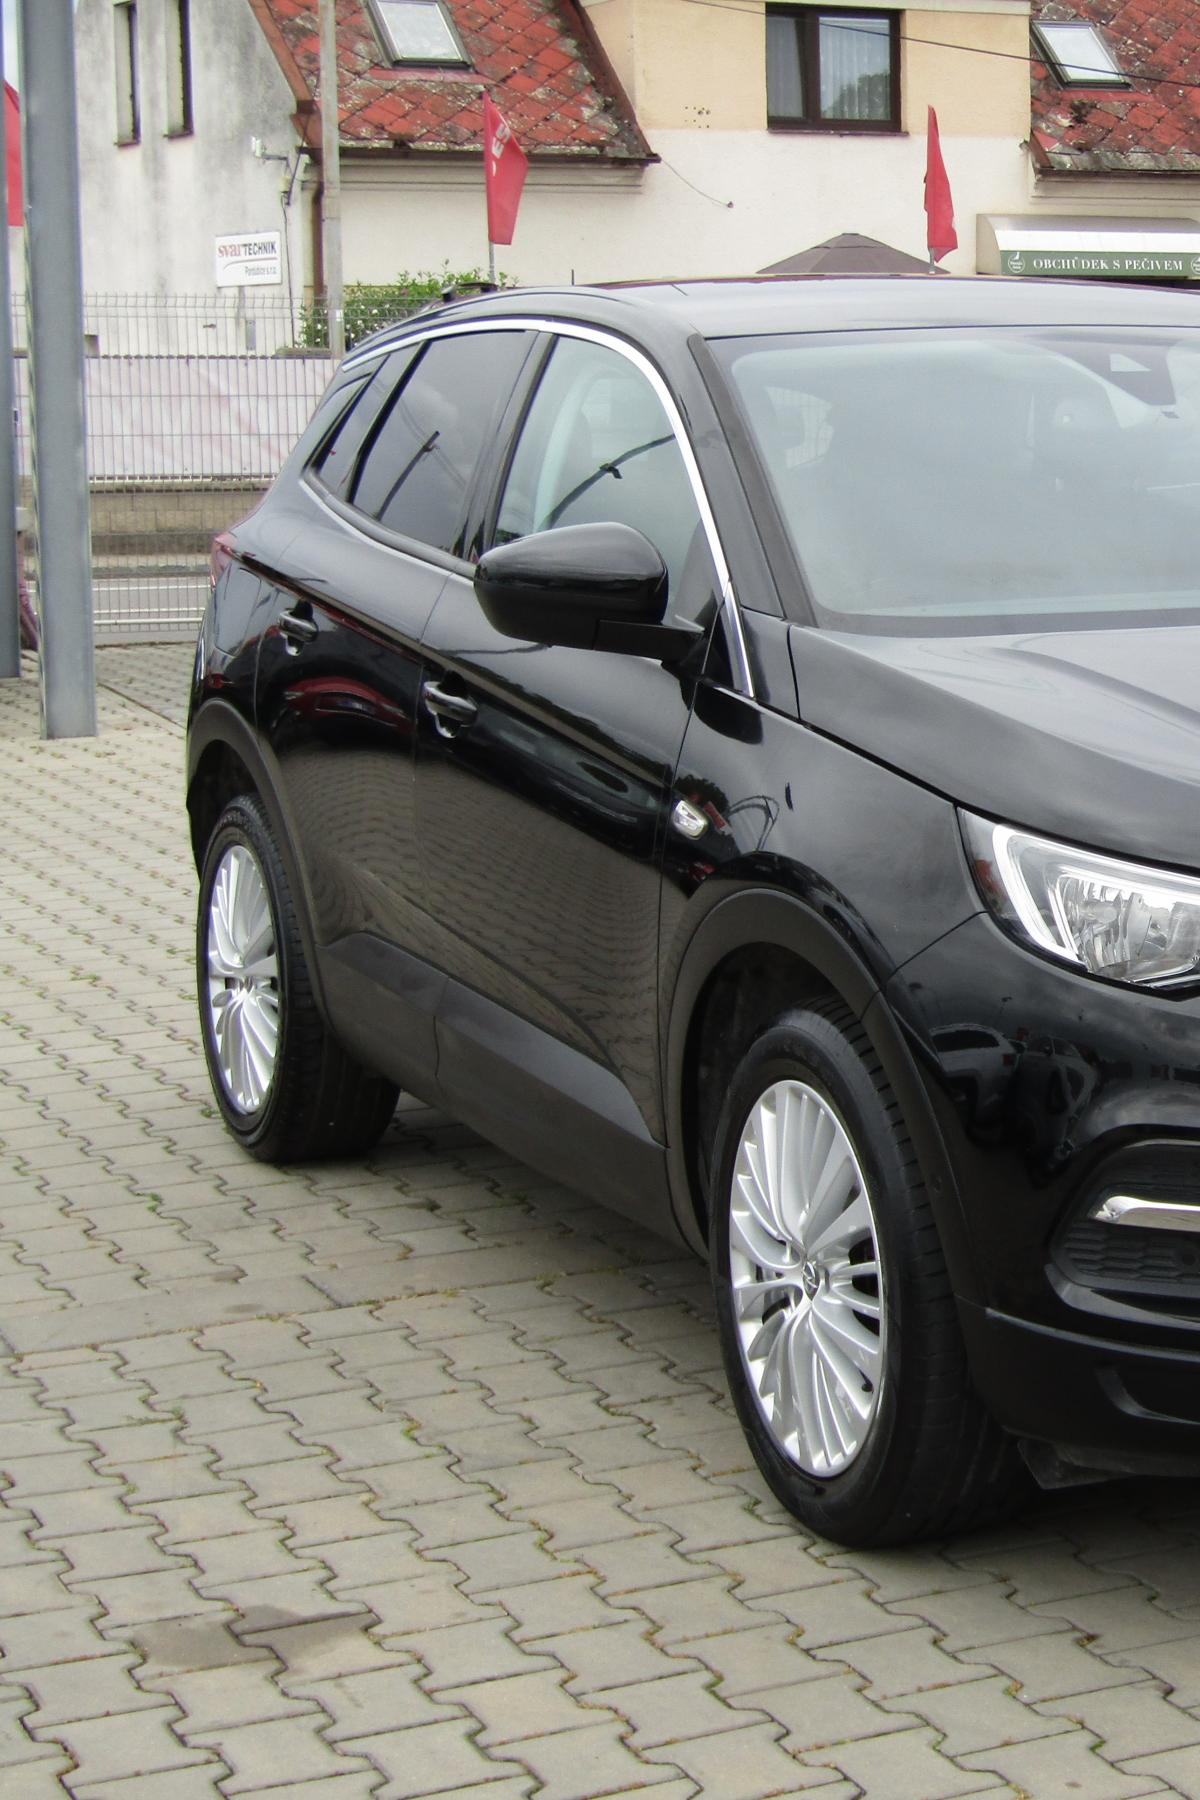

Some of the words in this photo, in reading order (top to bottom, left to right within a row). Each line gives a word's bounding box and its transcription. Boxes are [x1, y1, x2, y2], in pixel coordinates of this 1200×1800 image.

[1033, 255, 1109, 271] OBCHŮDEK
[1113, 258, 1121, 270] S
[1125, 256, 1184, 272] PEČIVEM
